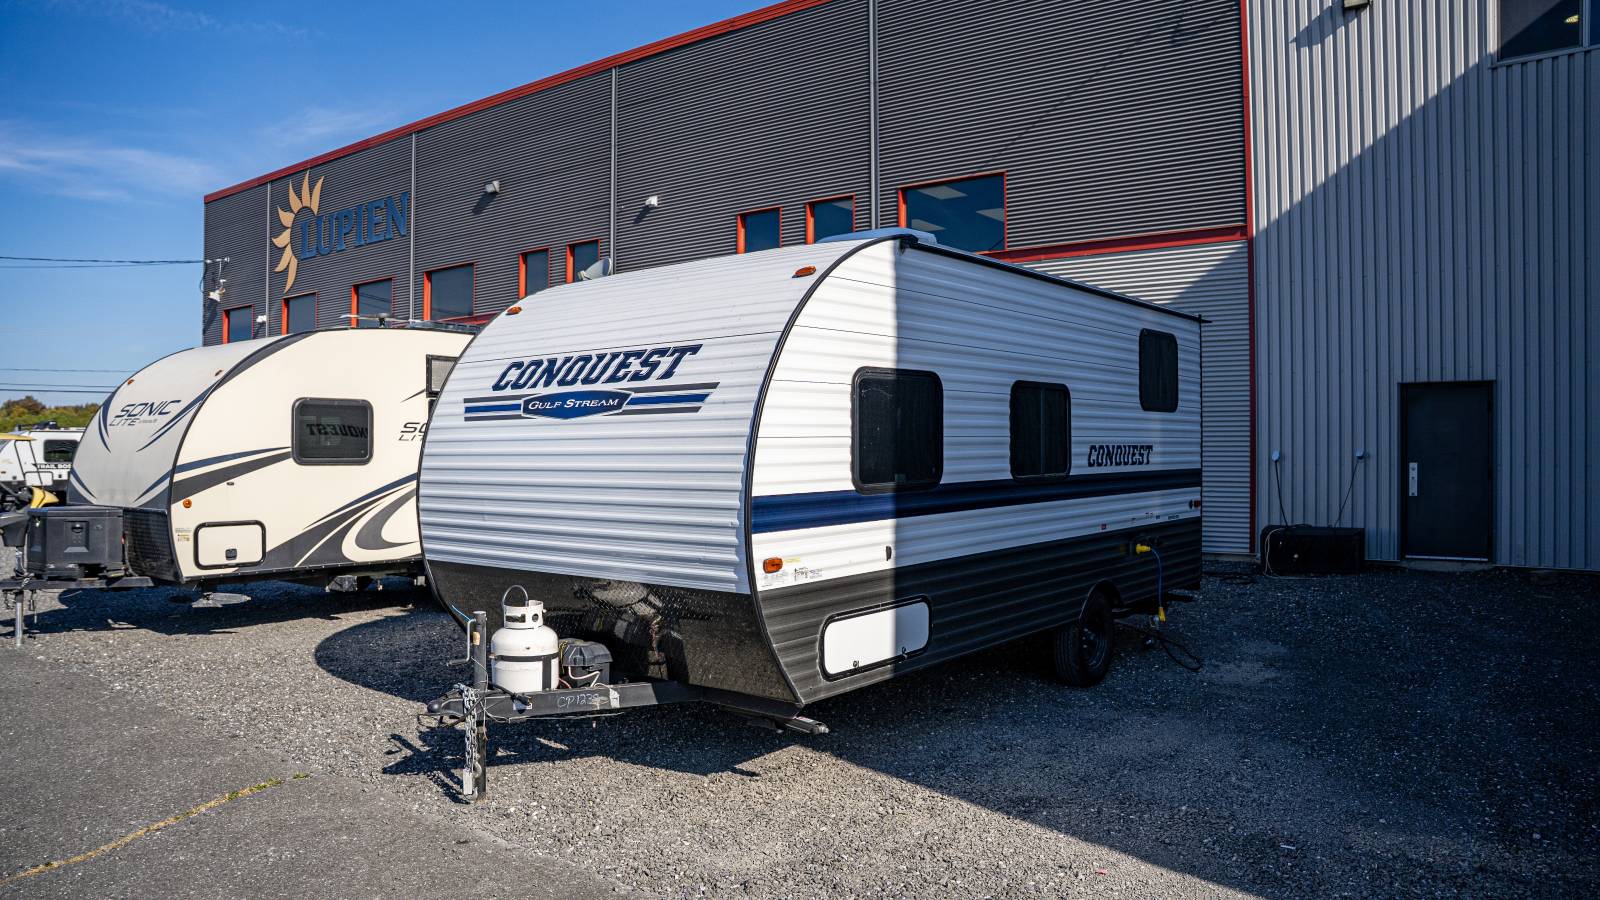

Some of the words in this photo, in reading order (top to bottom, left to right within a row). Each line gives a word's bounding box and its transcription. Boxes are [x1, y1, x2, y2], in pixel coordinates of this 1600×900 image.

[299, 191, 409, 260] LUPIEN
[491, 343, 703, 392] CONQUEST
[114, 399, 182, 419] SONIC
[528, 401, 562, 410] GULF
[564, 398, 620, 408] STREAM
[109, 417, 140, 427] LITE
[1087, 444, 1154, 467] CONQUEST
